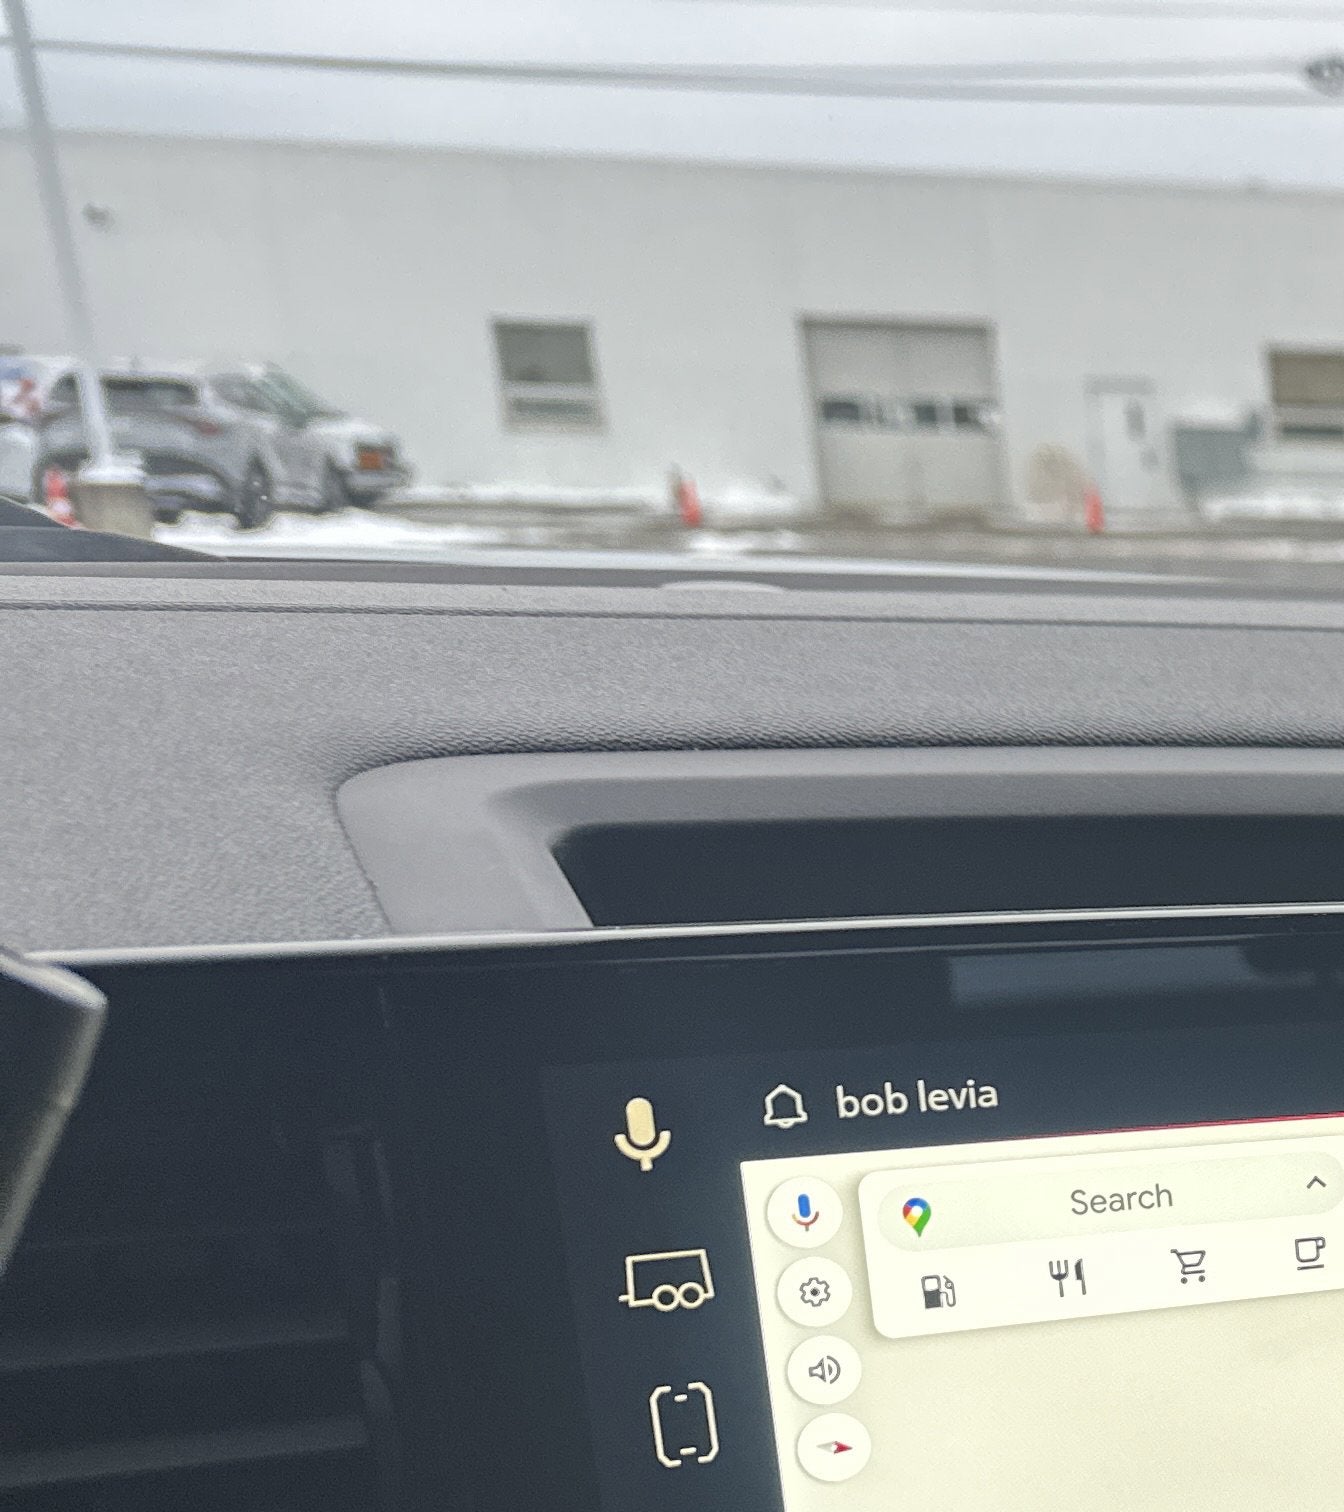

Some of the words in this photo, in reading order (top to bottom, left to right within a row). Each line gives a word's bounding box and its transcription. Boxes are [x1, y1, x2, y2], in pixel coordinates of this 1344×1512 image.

[836, 1081, 908, 1118] bob
[916, 1079, 999, 1112] levia
[1071, 1183, 1173, 1215] Search
